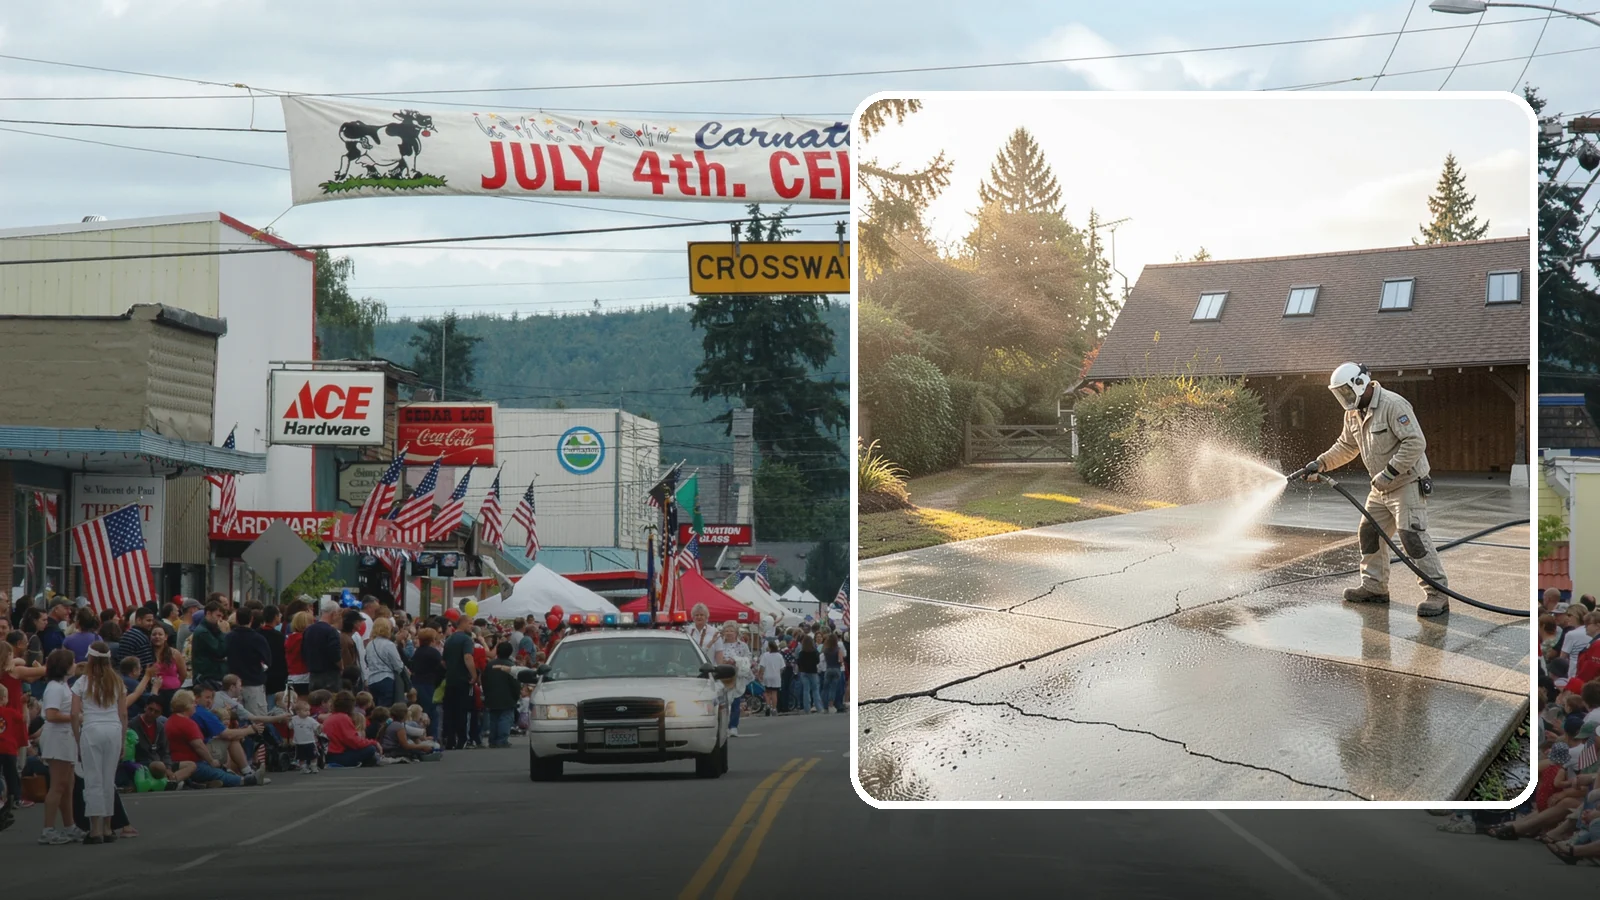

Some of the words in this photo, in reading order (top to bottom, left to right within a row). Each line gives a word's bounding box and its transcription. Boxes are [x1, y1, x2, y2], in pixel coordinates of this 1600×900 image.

[481, 141, 605, 193] JULY
[632, 150, 746, 198] 4th.
[697, 255, 850, 280] CROSSWA
[283, 380, 373, 420] ACE
[405, 409, 453, 422] CEDAR
[461, 409, 485, 422] LOG
[284, 421, 370, 436] Hardware
[416, 428, 477, 447] Coca-Cola
[353, 467, 386, 480] Simpl
[95, 485, 124, 494] Vincent
[126, 486, 136, 494] de
[137, 486, 155, 495] Paul
[212, 516, 330, 535] HARDARE
[688, 526, 741, 535] CRNATION
[699, 535, 730, 543] GLASS
